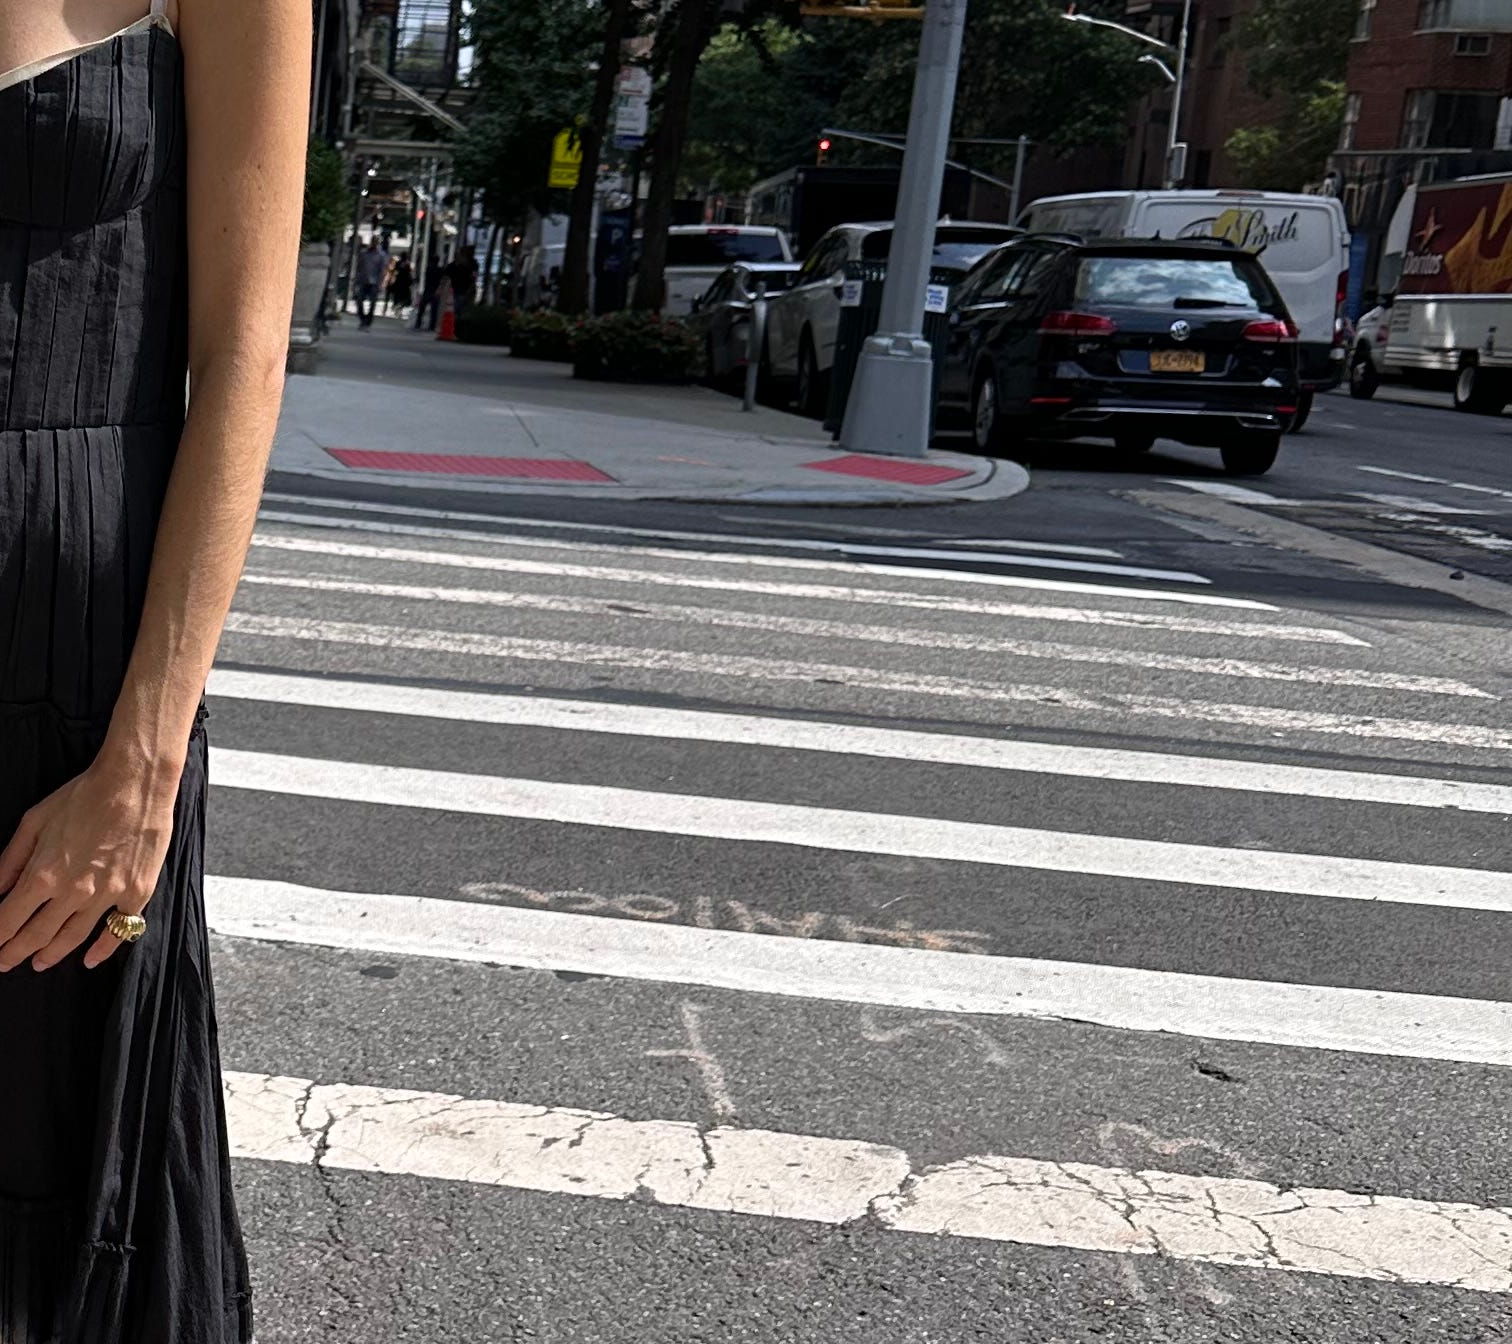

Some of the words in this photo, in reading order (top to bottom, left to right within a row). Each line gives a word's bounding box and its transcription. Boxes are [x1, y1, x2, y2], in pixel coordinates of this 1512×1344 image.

[1403, 250, 1444, 275] Doritos
[926, 723, 977, 746] ONE
[1001, 727, 1054, 751] WAY
